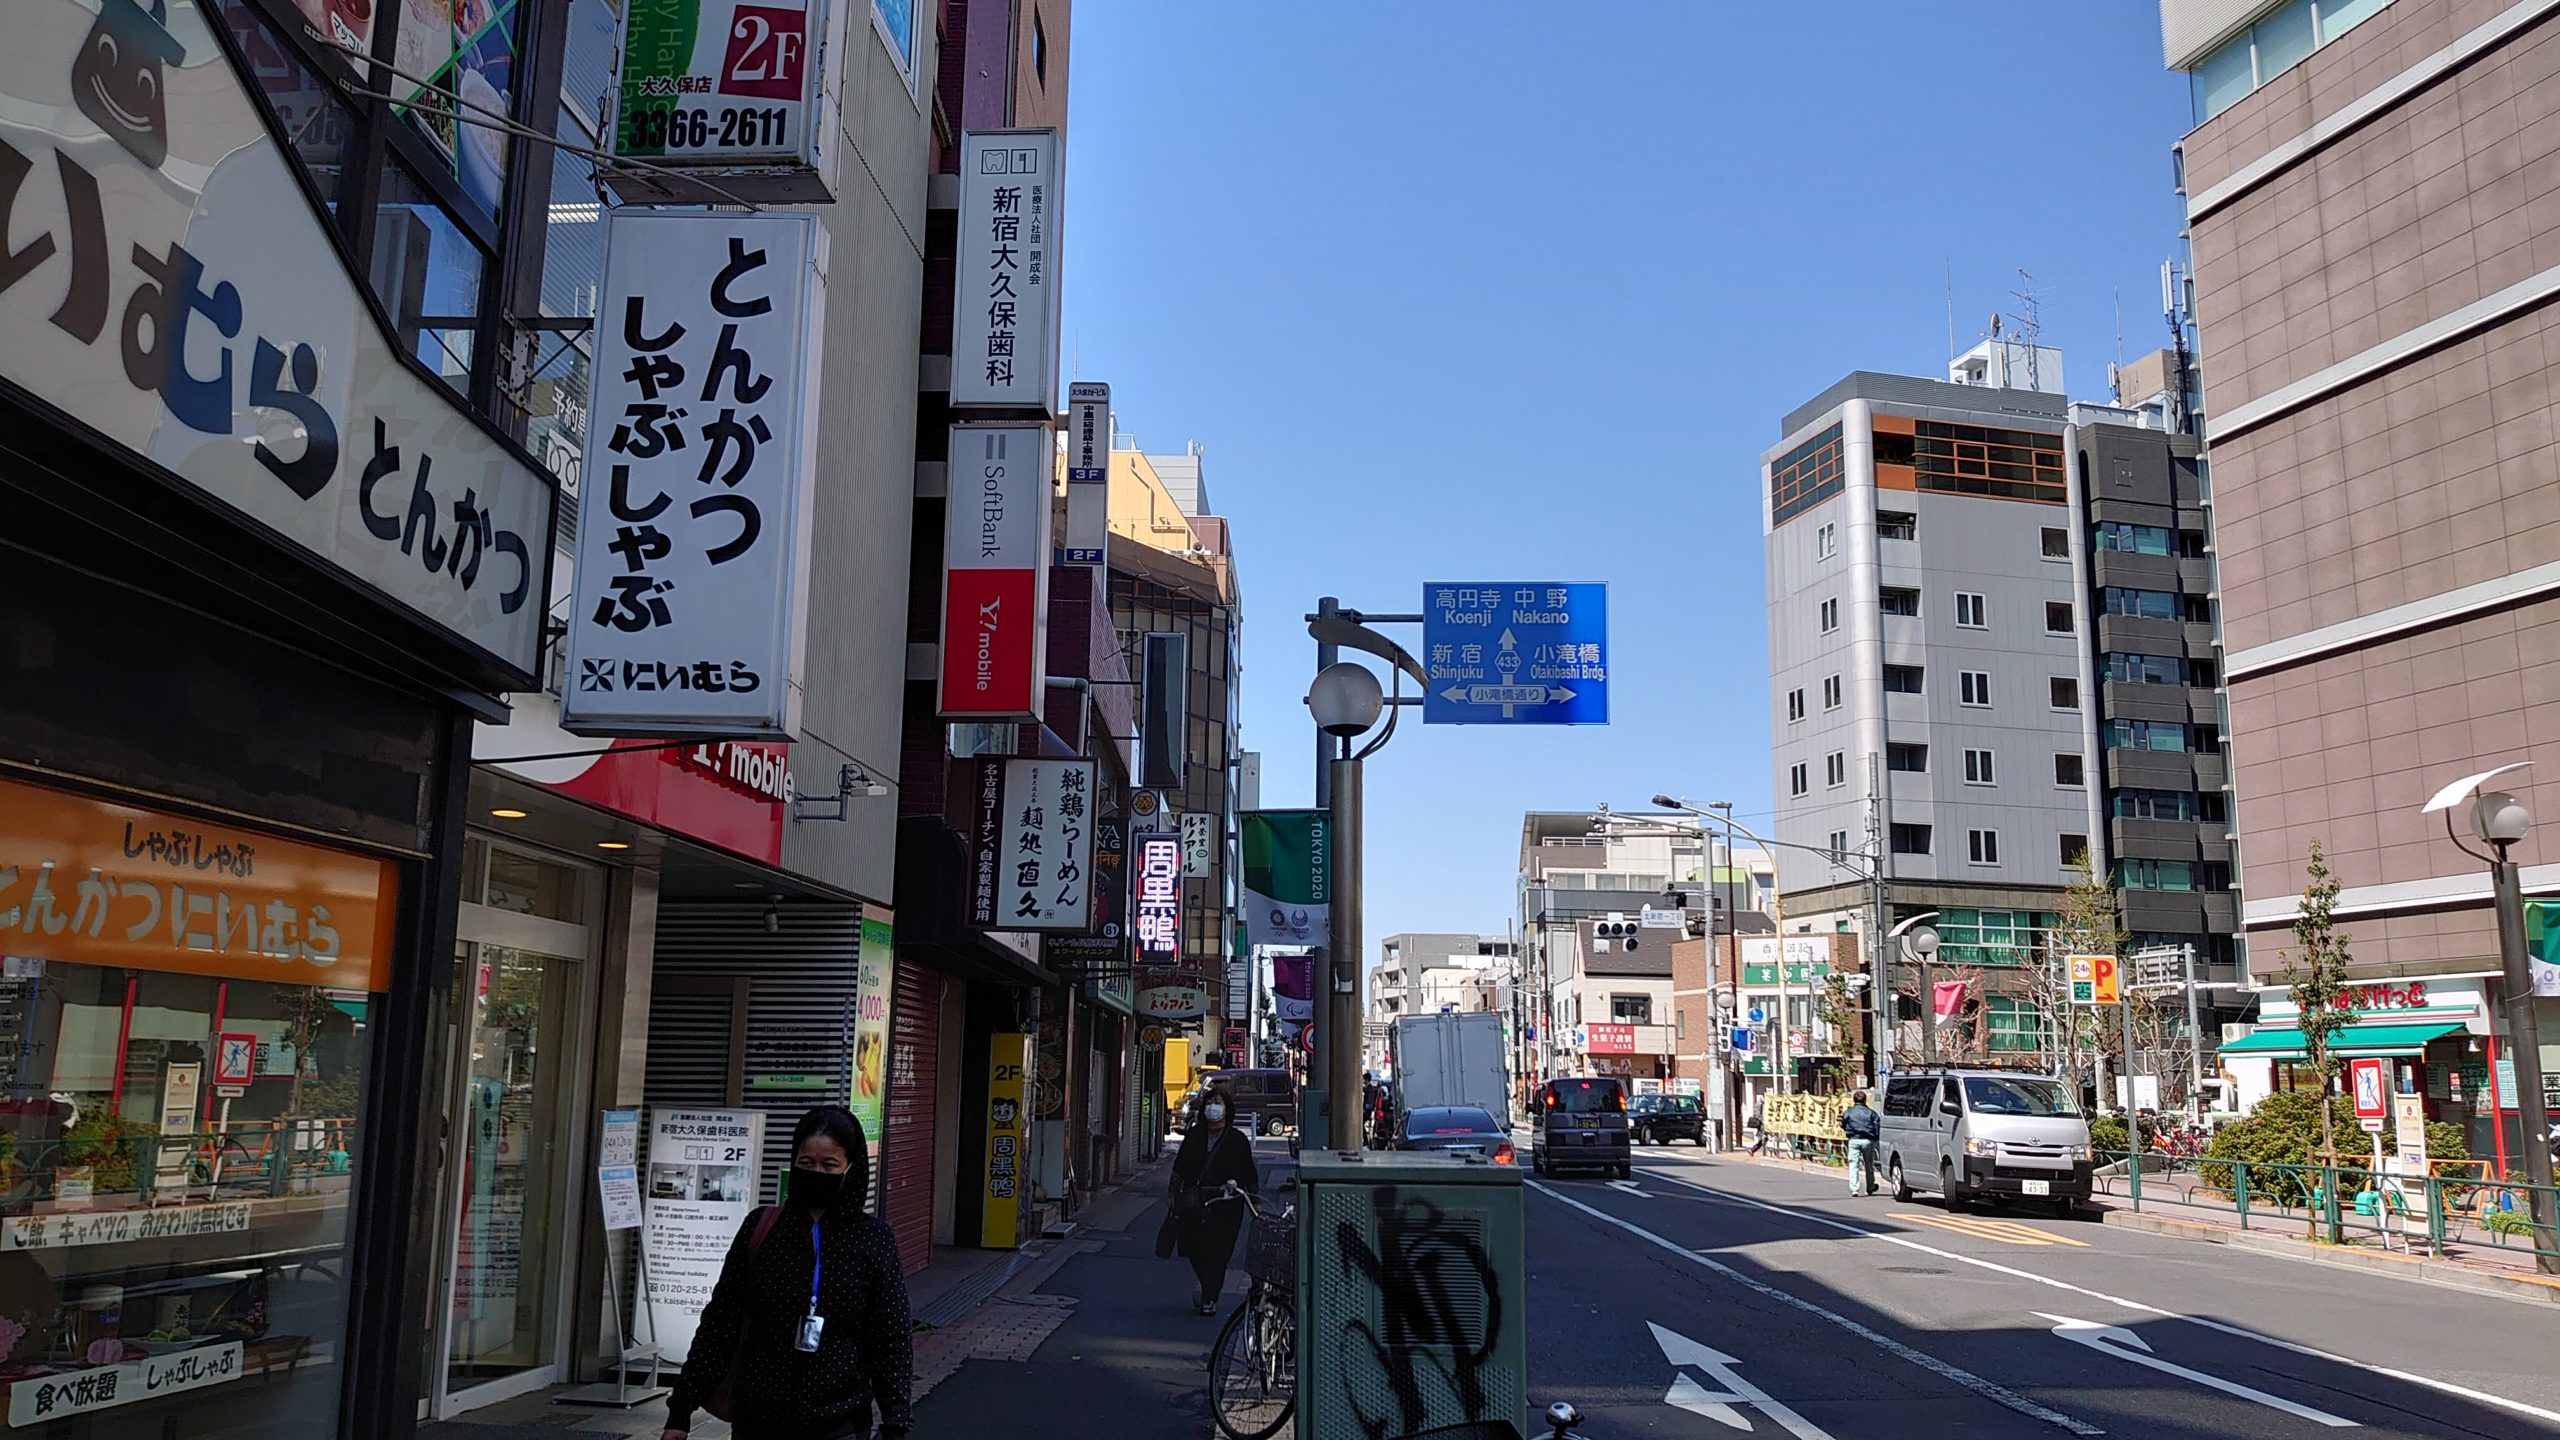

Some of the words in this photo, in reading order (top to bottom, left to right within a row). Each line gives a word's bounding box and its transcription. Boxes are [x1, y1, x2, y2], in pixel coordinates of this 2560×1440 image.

[731, 15, 802, 81] 2F
[639, 77, 713, 95] 大久保店
[629, 108, 787, 148] 3366-2611
[1030, 185, 1043, 244] 医療法人社団
[1029, 250, 1042, 285] 開成会
[985, 186, 1022, 387] 新宿大久保歯科
[689, 237, 774, 566] とんかつ
[592, 296, 688, 633] しゃぶしゃぶ
[1075, 469, 1099, 479] 3F
[359, 415, 531, 614] とんかつ
[981, 465, 1005, 559] SoftBank
[1072, 551, 1097, 561] 2F
[979, 596, 1001, 632] Y!
[1436, 588, 1502, 609] 高円寺
[1514, 587, 1569, 609] 中野
[1445, 610, 1492, 627] Koenji
[1512, 610, 1570, 625] Nakano
[976, 632, 992, 692] mobile
[1432, 643, 1483, 664] 新宿
[1499, 656, 1518, 668] 433
[1534, 643, 1601, 664] 小滝橋
[623, 661, 760, 693] にいむら
[1431, 665, 1484, 681] Shinjuku
[1531, 664, 1581, 681] Otakibashi
[1582, 665, 1607, 682] Brdg.
[1475, 687, 1540, 702] 小滝橋通り
[730, 743, 795, 803] mobile
[975, 763, 999, 923] 名古屋コーチン、自家製麺使用
[1018, 805, 1044, 856] 麺処
[1056, 768, 1086, 907] 純鶏らーめん
[1183, 816, 1197, 874] ルノアール
[1311, 821, 1323, 865] TOKYO
[122, 821, 256, 877] しゃぶしゃぶ
[1015, 858, 1042, 919] 直久
[1311, 866, 1323, 899] 2020
[2074, 963, 2091, 973] 24h
[2095, 960, 2113, 987] P
[1150, 999, 1194, 1011] トリアノン
[2297, 982, 2429, 1011] ばすけっと
[994, 1064, 1022, 1082] 2F
[661, 1123, 750, 1137] 新宿大久保歯科医院
[723, 1147, 747, 1161] 2F
[14, 1216, 47, 1248] ご飯
[58, 1214, 130, 1245] キャベツの
[139, 1204, 250, 1237] おかわりは無料です
[660, 1283, 713, 1295] 0120-25-81
[34, 1369, 119, 1417] 食べ放題
[147, 1349, 236, 1390] しゃぶしゃぶ
